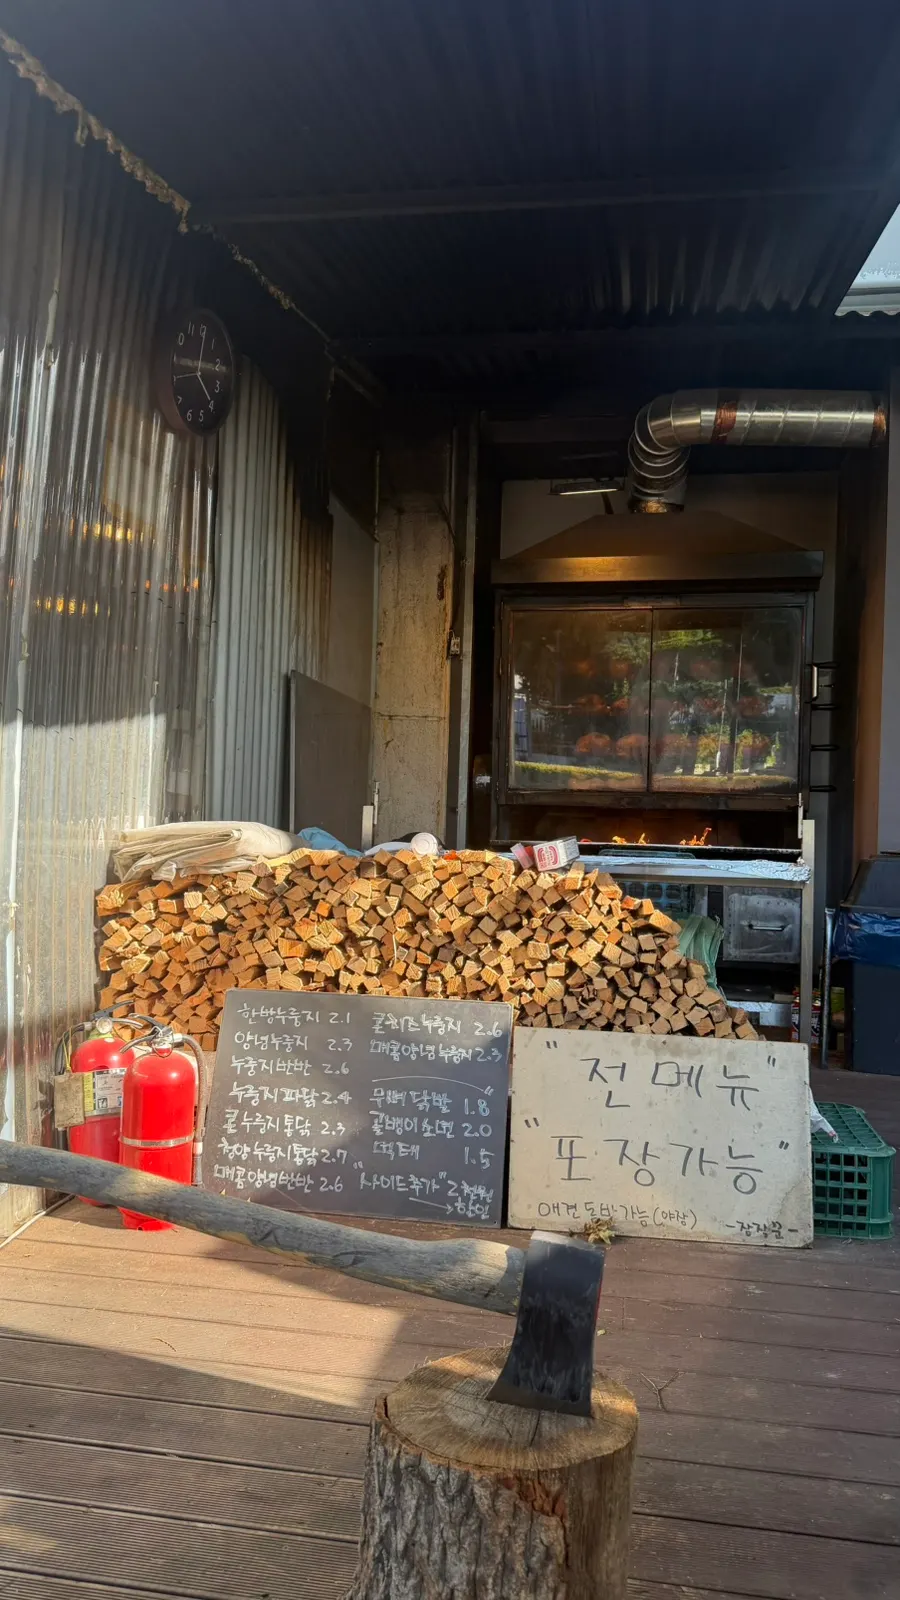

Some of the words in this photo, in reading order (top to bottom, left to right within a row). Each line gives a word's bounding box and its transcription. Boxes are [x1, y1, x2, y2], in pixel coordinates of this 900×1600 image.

[329, 1012, 351, 1024] 2.1
[474, 1021, 503, 1038] 2.6
[327, 1038, 353, 1051] 2.3
[475, 1047, 502, 1063] 2.3
[322, 1062, 350, 1075] 2.6
[321, 1091, 352, 1105] 2.4
[464, 1098, 490, 1116] 1.8
[321, 1121, 346, 1136] 2.3
[462, 1122, 492, 1138] 2.0
[321, 1149, 347, 1164] 2.7
[464, 1147, 495, 1169] 1.5
[319, 1176, 343, 1192] 2.6
